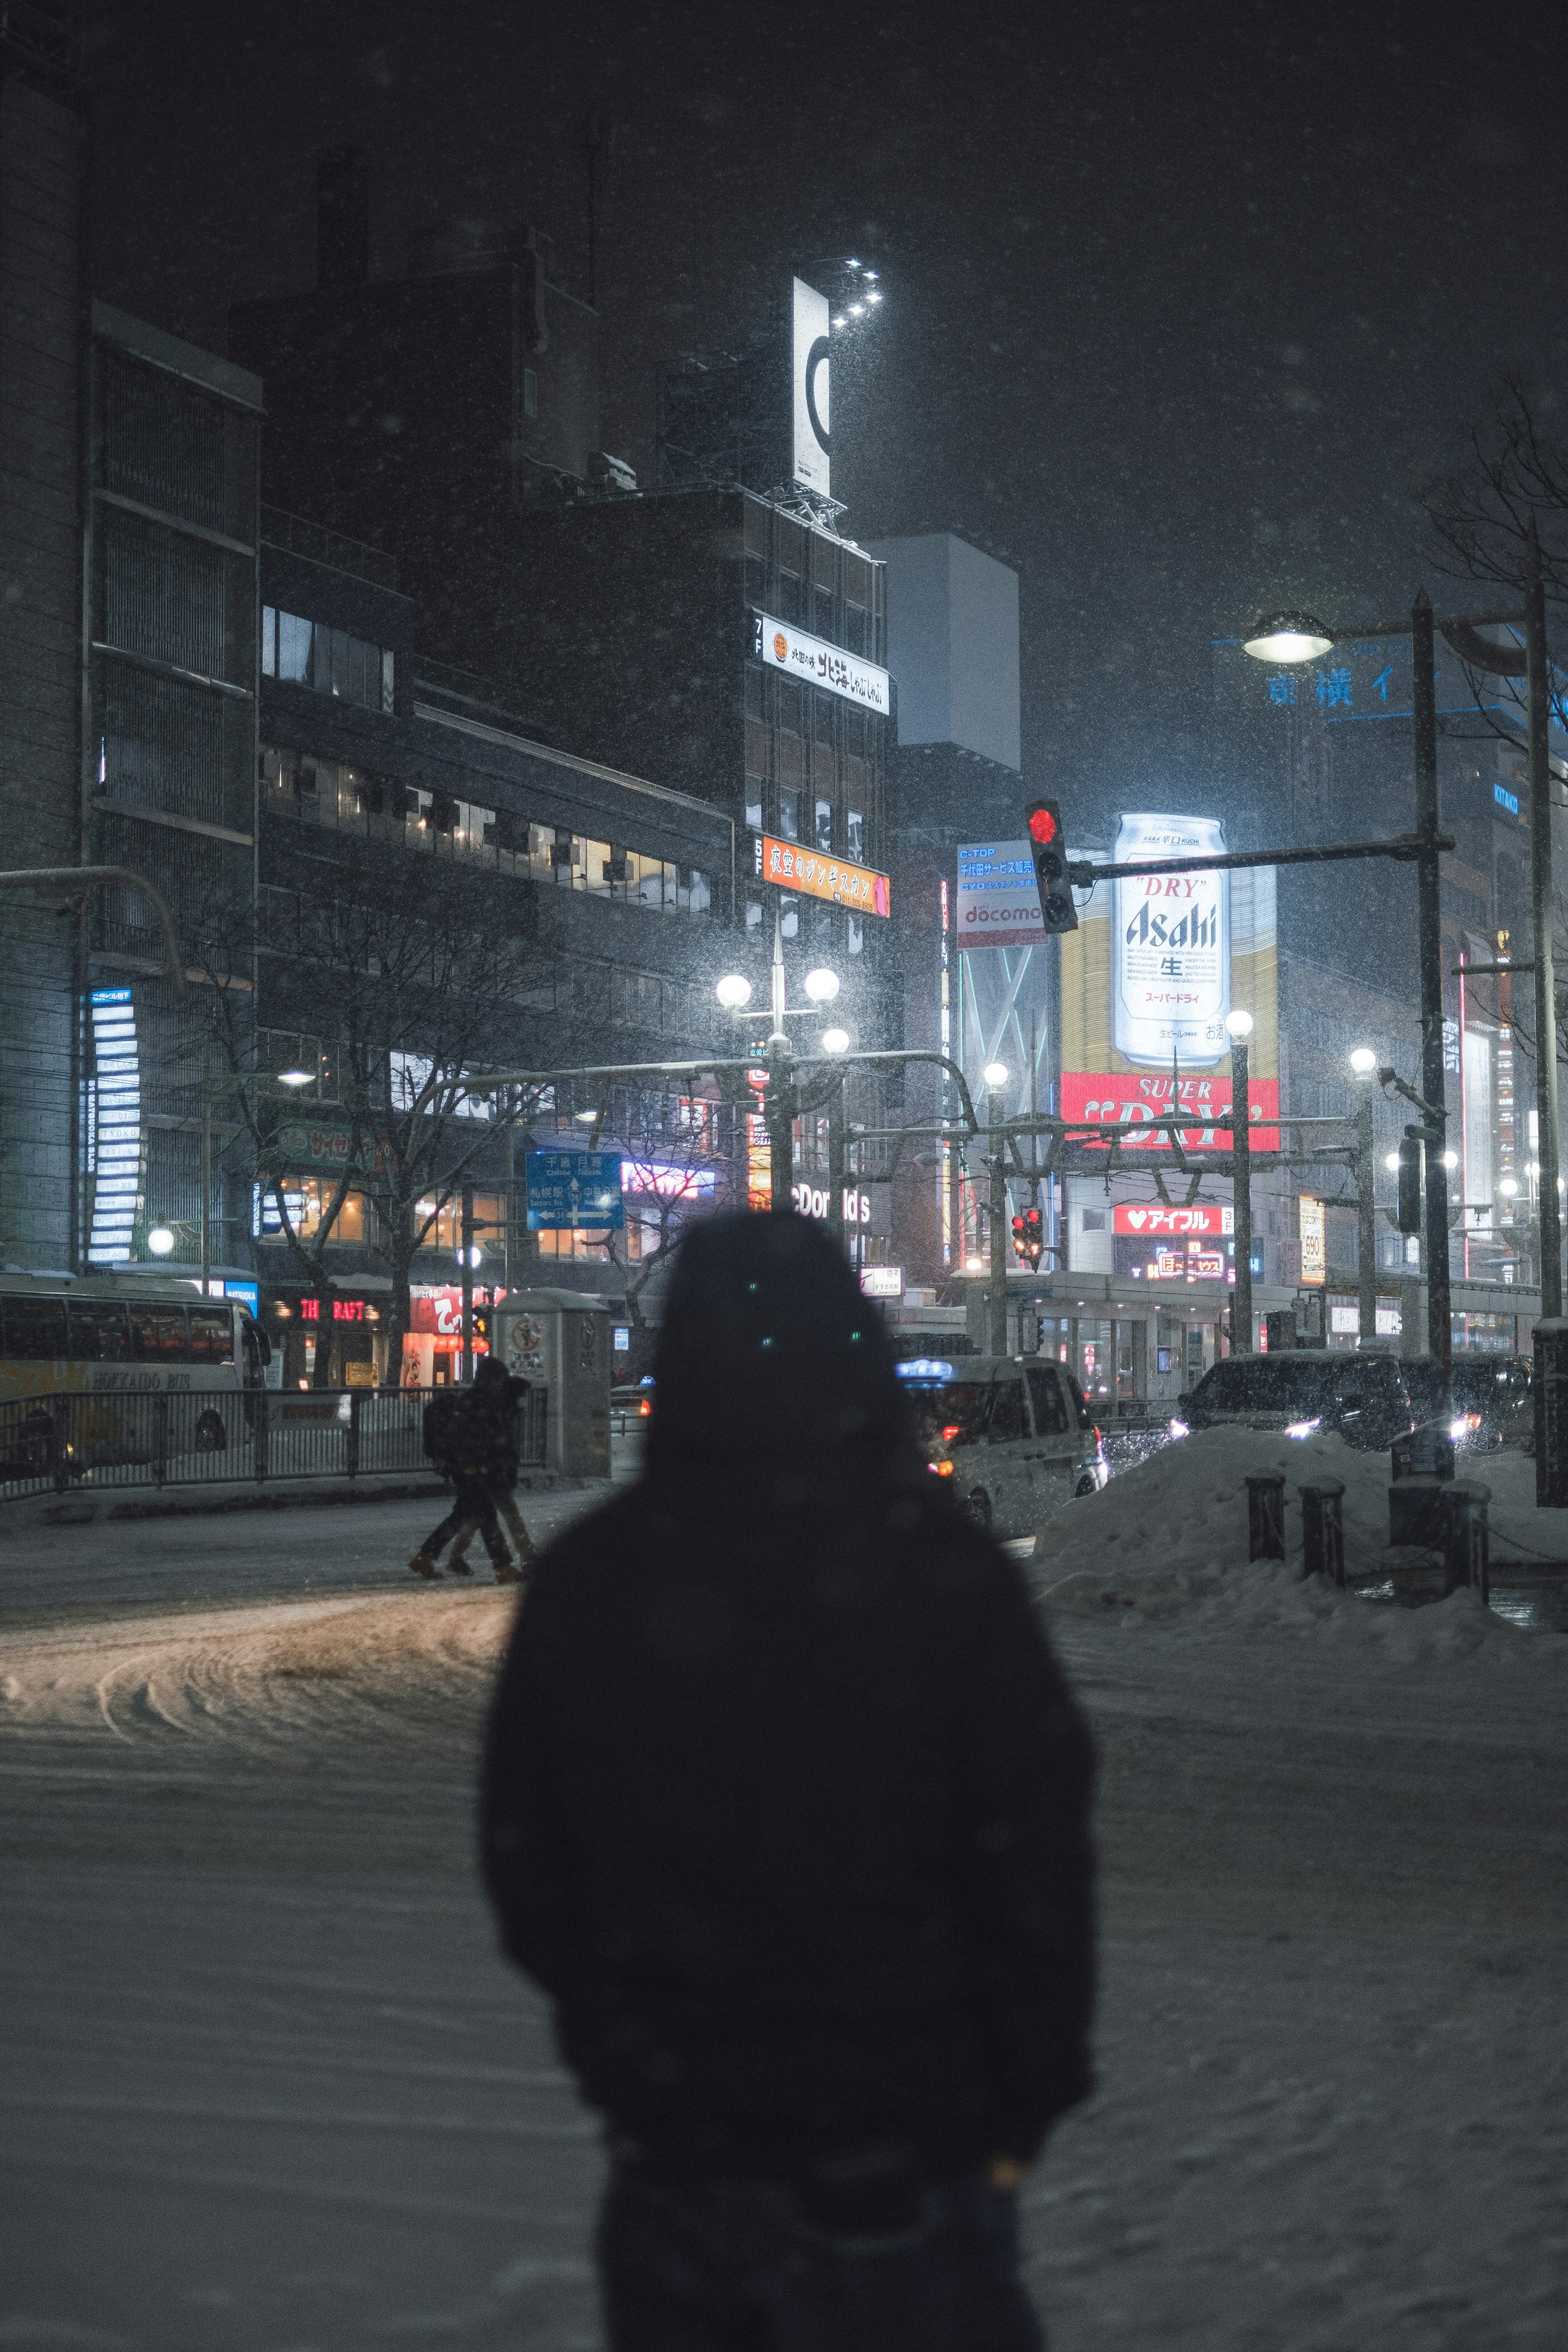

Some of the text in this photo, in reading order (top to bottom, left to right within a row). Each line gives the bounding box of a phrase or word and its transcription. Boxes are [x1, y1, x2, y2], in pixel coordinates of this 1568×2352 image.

[960, 848, 995, 859] C-TOP
[770, 844, 869, 899] 夜空のジンギスカン
[965, 905, 1041, 923] docomo
[1127, 900, 1216, 948] Asahi
[1160, 957, 1183, 976] 生
[1146, 993, 1199, 1003] スーパードライ
[1137, 1079, 1212, 1099] SUPER
[547, 1156, 570, 1167] 千歳
[530, 1187, 564, 1198] 札幌駅
[584, 1187, 621, 1198] 中島公園
[1148, 1210, 1209, 1229] アイフル
[227, 1291, 256, 1300] MATSUOKA
